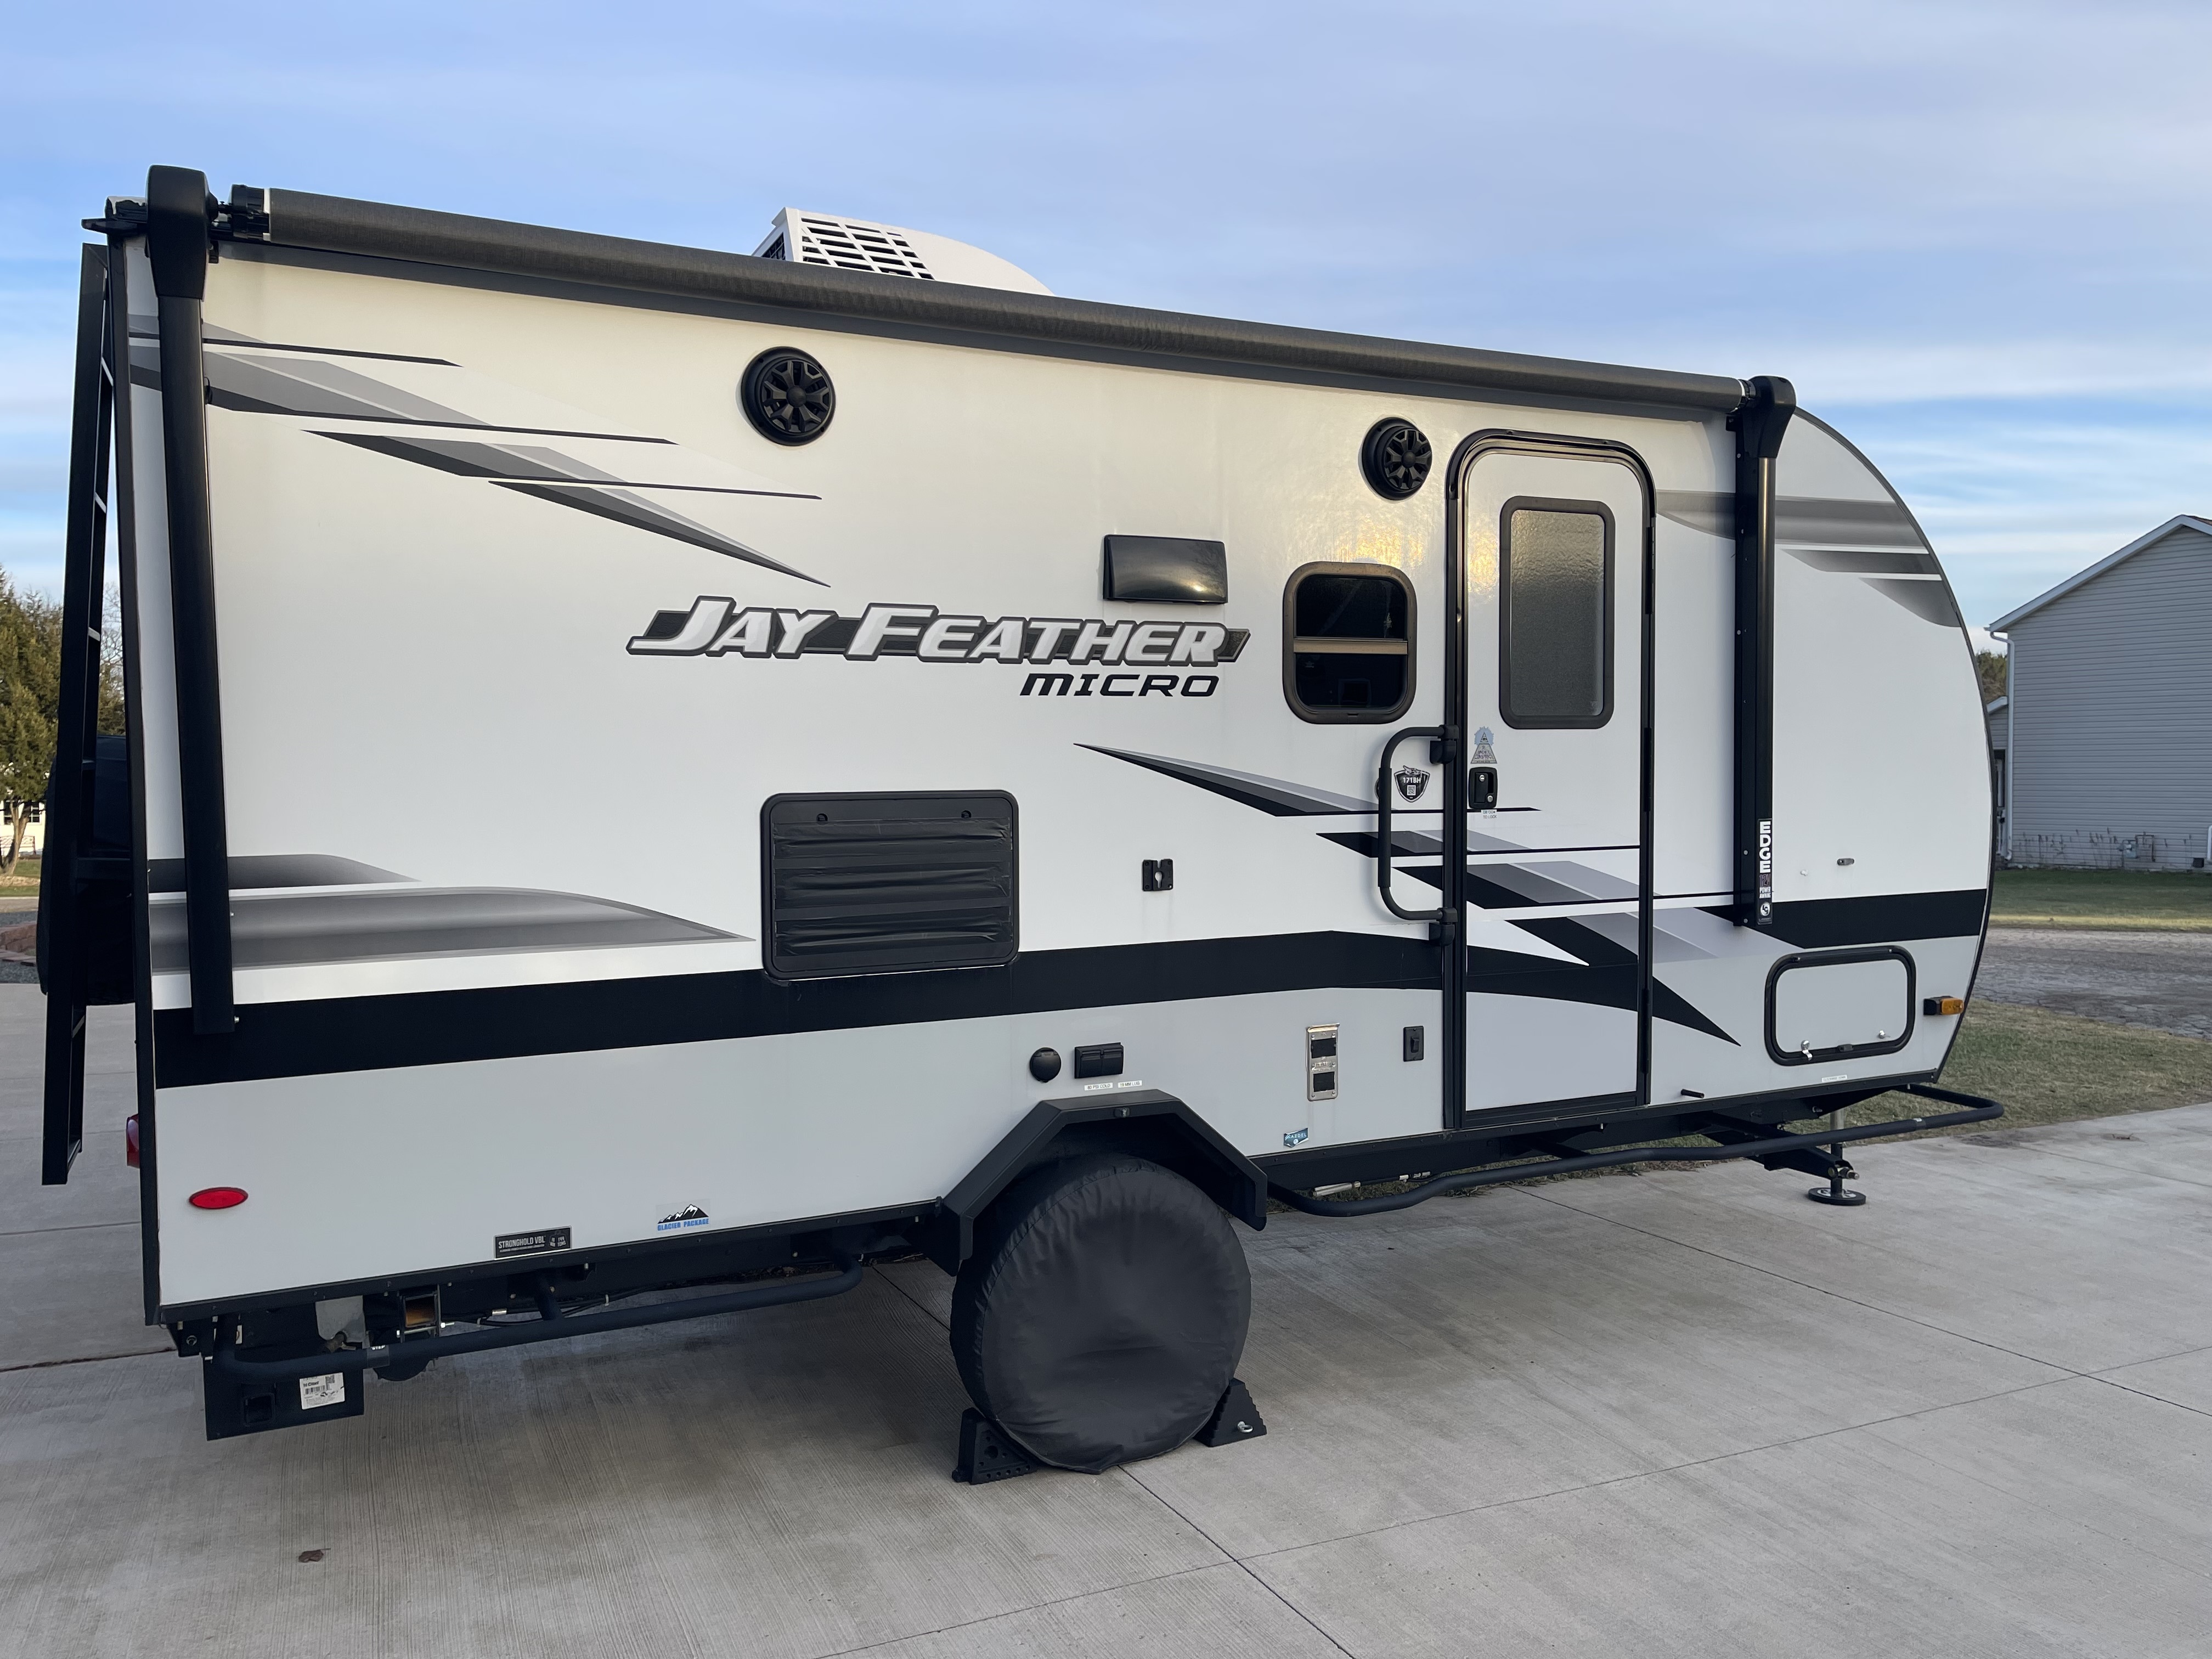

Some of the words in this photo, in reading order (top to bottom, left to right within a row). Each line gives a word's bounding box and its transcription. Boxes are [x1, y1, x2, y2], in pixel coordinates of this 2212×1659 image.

[627, 595, 838, 658] JAY
[844, 602, 1229, 667] FEATHER
[1020, 673, 1219, 698] MICRO
[1759, 821, 1771, 873] EDGE
[657, 1222, 681, 1231] GLACIER
[683, 1218, 709, 1227] PACKAGE
[498, 1237, 534, 1249] STRONGHOLD
